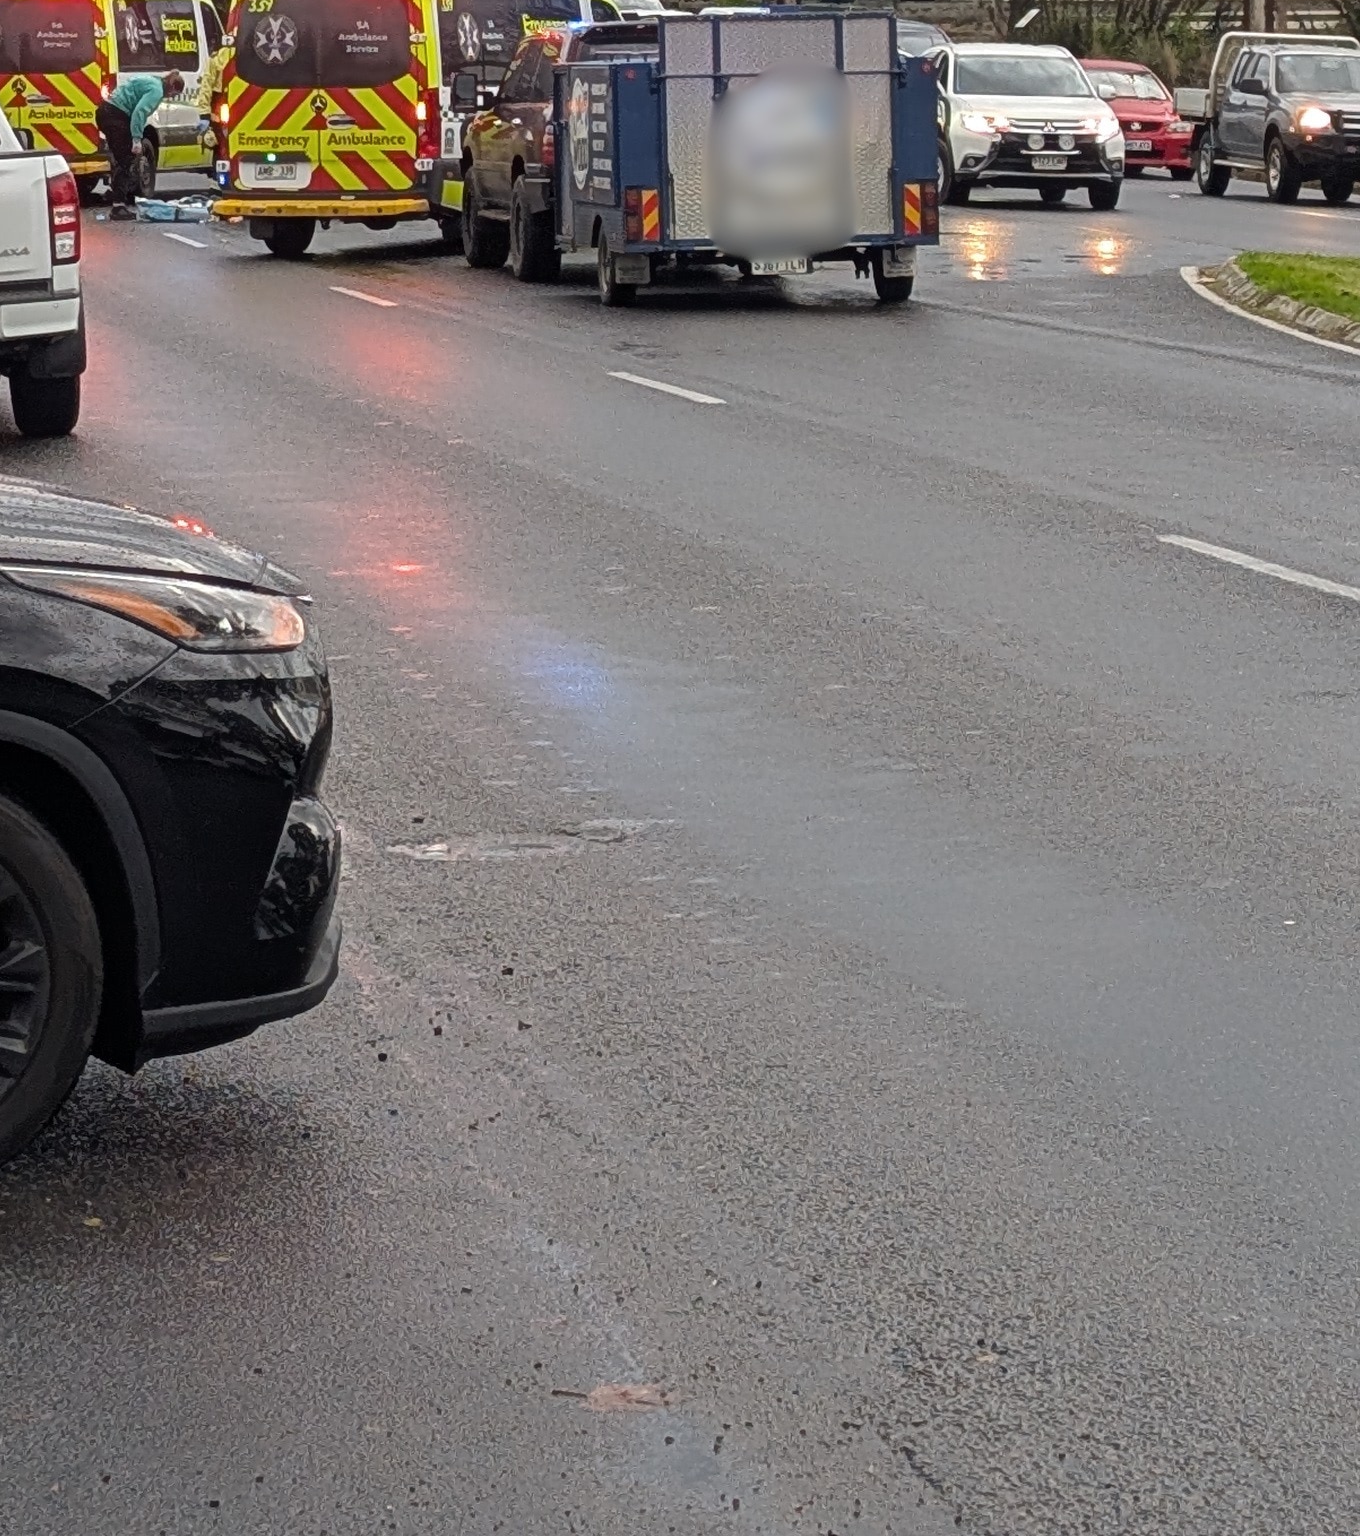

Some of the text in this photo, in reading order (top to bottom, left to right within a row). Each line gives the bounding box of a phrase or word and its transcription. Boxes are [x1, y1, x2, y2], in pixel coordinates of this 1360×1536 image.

[338, 33, 388, 41] Ambulance
[28, 108, 94, 120] Ambulance
[237, 132, 407, 149] Emergency Ambulance
